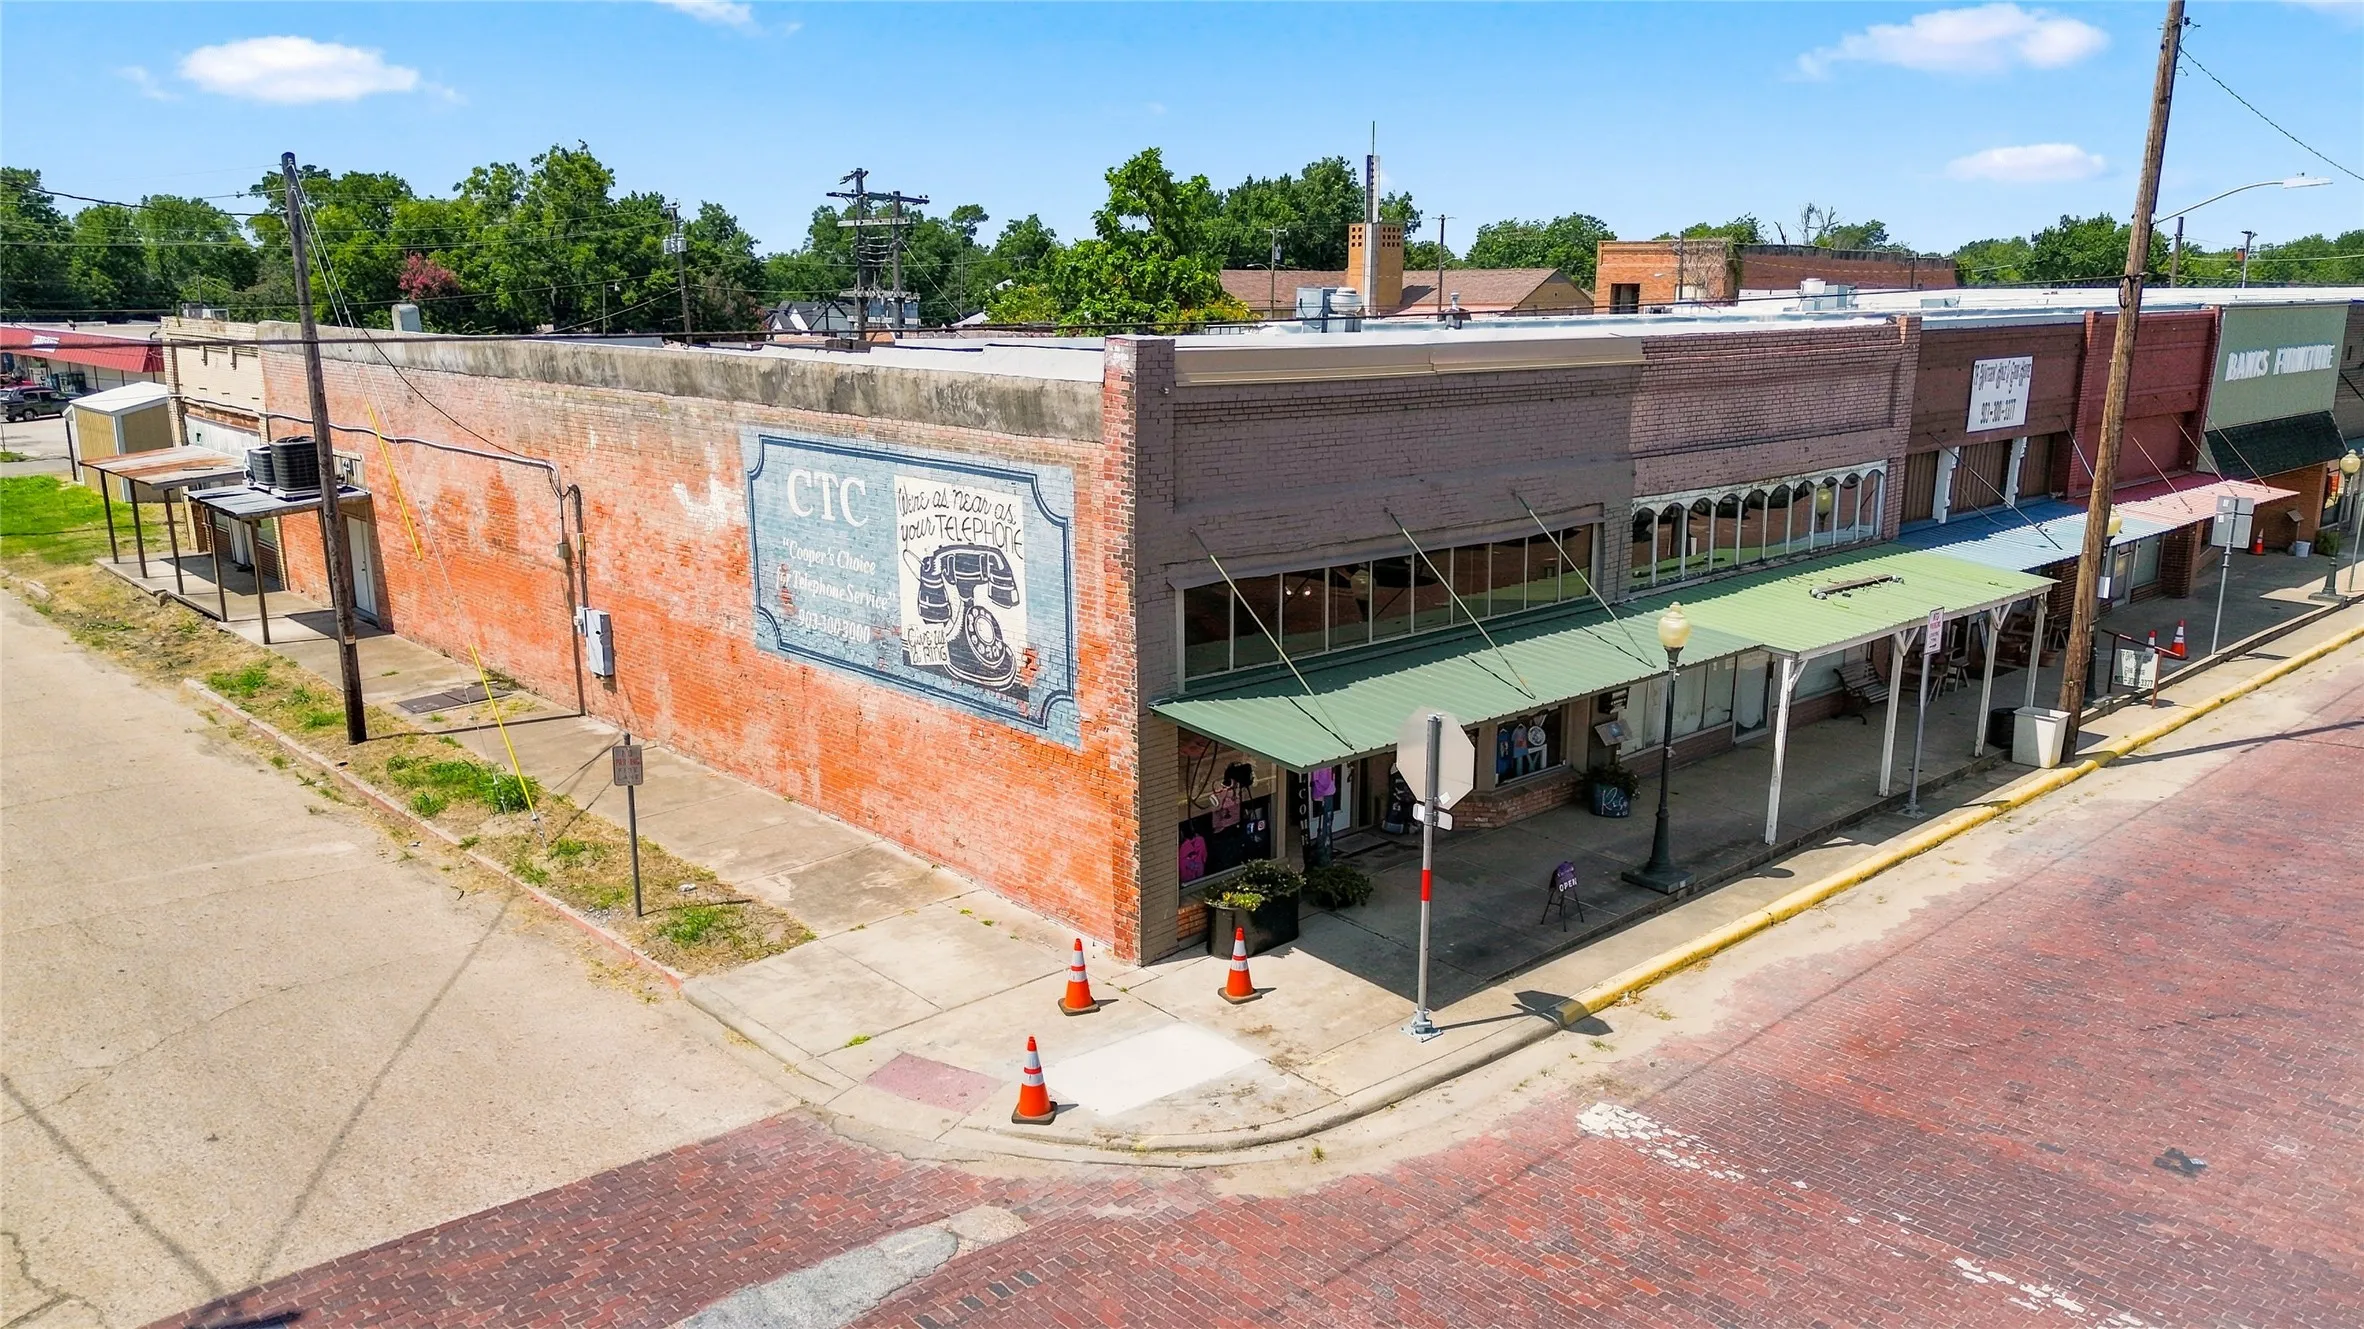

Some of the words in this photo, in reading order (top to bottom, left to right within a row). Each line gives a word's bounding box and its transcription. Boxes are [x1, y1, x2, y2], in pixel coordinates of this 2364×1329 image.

[2224, 349, 2270, 381] BANKS
[787, 468, 869, 528] CTC
[932, 488, 950, 509] as
[953, 489, 992, 515] near
[994, 503, 1017, 526] as
[901, 516, 936, 551] your
[935, 514, 1024, 559] TELEPHONE
[836, 551, 876, 576] Choice
[776, 566, 792, 590] for
[792, 570, 845, 597] Telephone
[908, 627, 932, 648] Give
[923, 645, 948, 663] RING
[1559, 878, 1577, 892] OPEN
